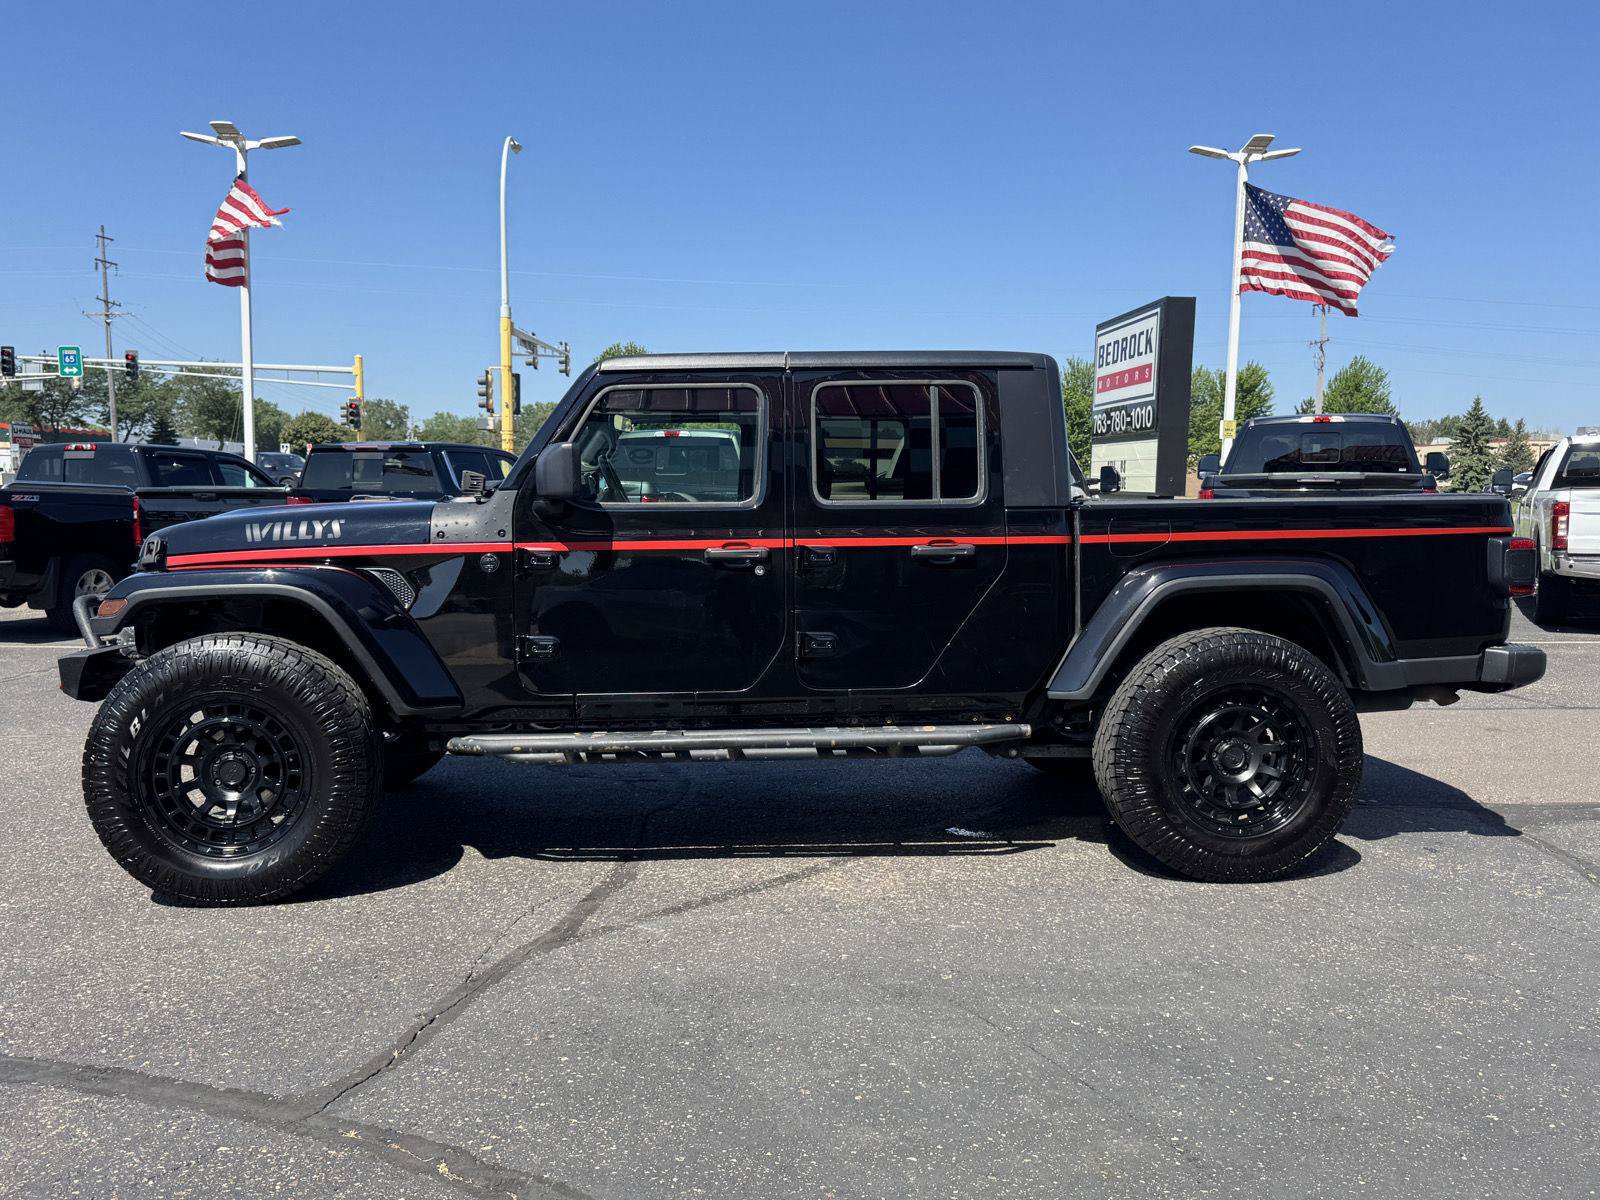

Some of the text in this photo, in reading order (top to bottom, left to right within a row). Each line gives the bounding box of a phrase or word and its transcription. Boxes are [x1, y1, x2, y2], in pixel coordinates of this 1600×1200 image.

[64, 355, 75, 363] 65
[1098, 328, 1153, 369] BEDROCK
[1098, 368, 1149, 389] MOTORS
[1093, 405, 1153, 434] 763-780-1010
[245, 519, 346, 542] WILLYS
